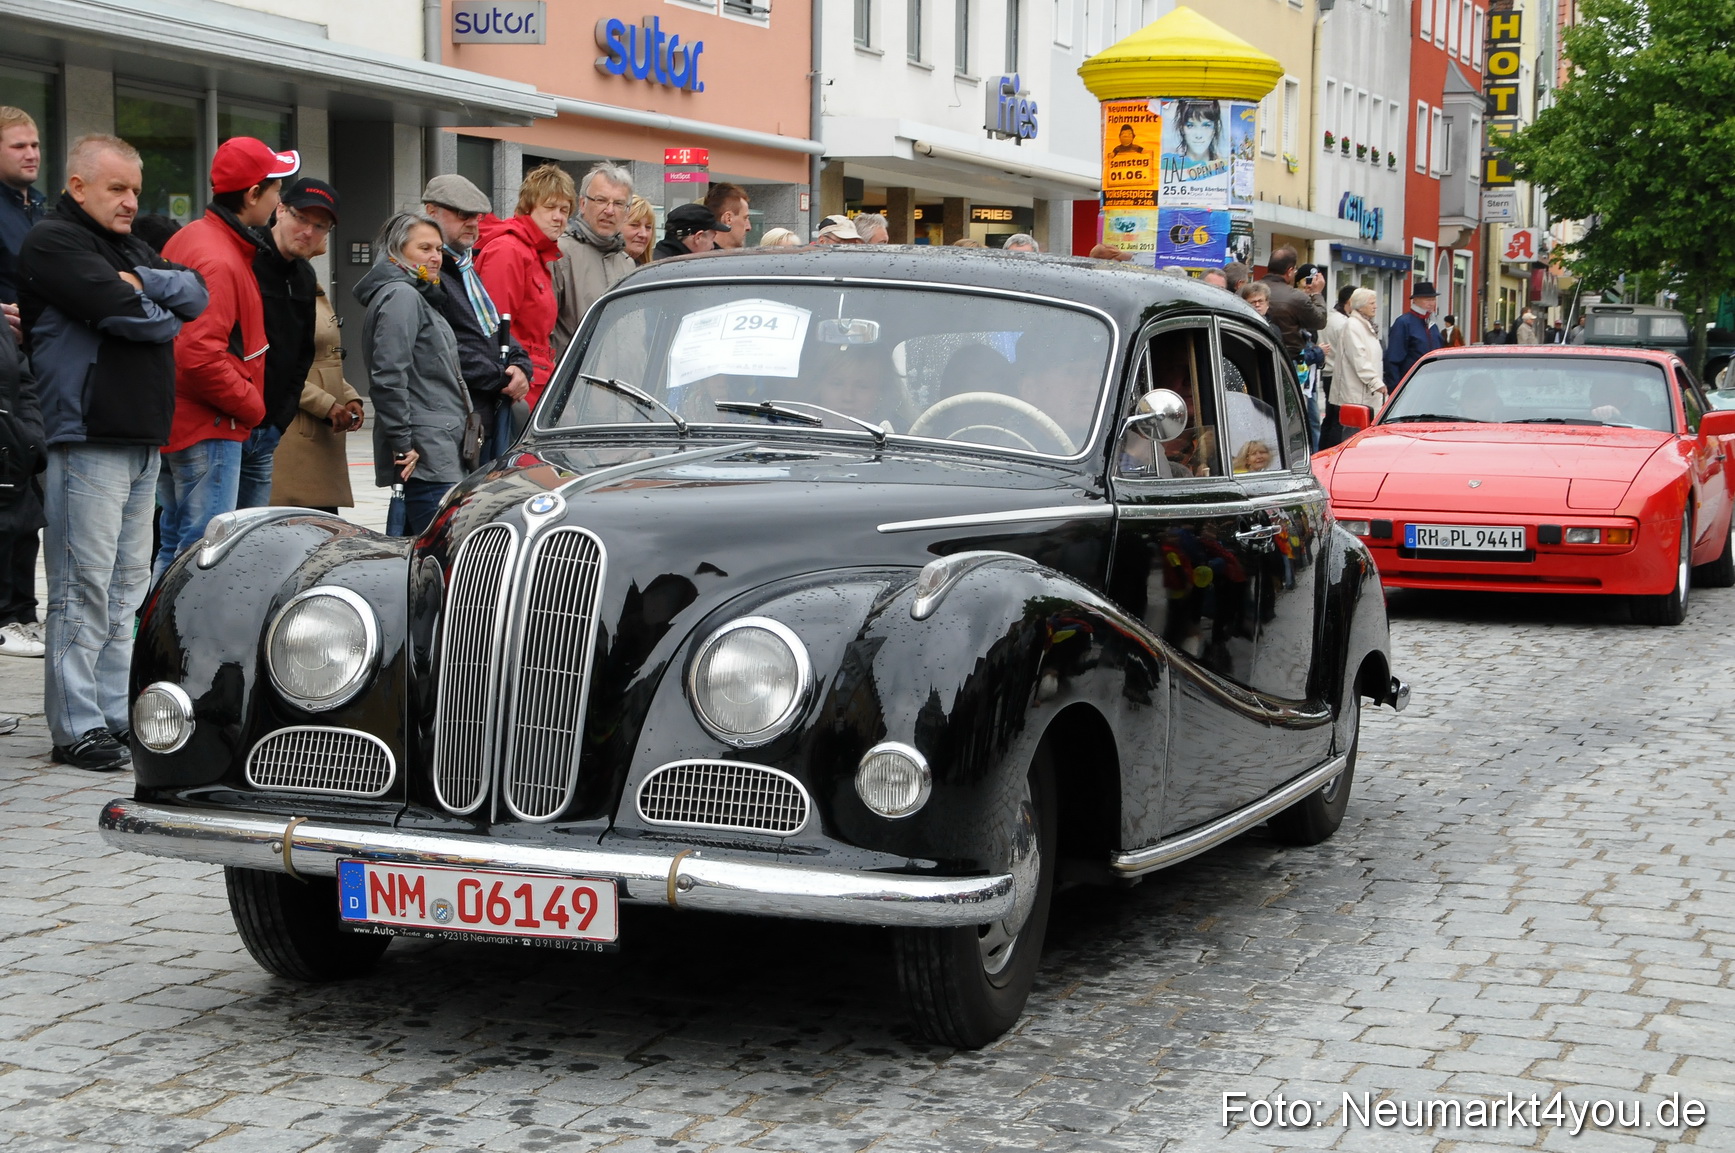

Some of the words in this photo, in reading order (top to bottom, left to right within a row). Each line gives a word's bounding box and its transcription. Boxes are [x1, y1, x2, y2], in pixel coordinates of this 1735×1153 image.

[455, 7, 536, 35] sutor.
[602, 15, 705, 93] sutor.
[997, 73, 1039, 140] fries
[1486, 14, 1520, 184] HOTEL
[1108, 114, 1159, 124] Flohmarkt
[1110, 158, 1150, 168] Samstag
[1163, 154, 1187, 184] ZAZ
[1189, 164, 1213, 180] OPEN
[1214, 160, 1226, 177] AIR
[1110, 170, 1147, 181] 01.06.
[305, 187, 335, 204] HONDA
[1105, 190, 1154, 199] Volksfestplatz
[1163, 185, 1190, 196] 25.6.
[1487, 199, 1509, 207] Stern
[972, 209, 1013, 221] FRIES
[1169, 225, 1210, 246] G6
[1127, 242, 1139, 250] Juni
[733, 315, 778, 331] 294
[1417, 528, 1439, 546] RH
[1451, 530, 1472, 547] PL
[350, 896, 359, 909] D
[369, 871, 426, 919] NM
[457, 877, 599, 932] 06149
[443, 930, 469, 942] 92318
[470, 933, 513, 945] Neumarkt
